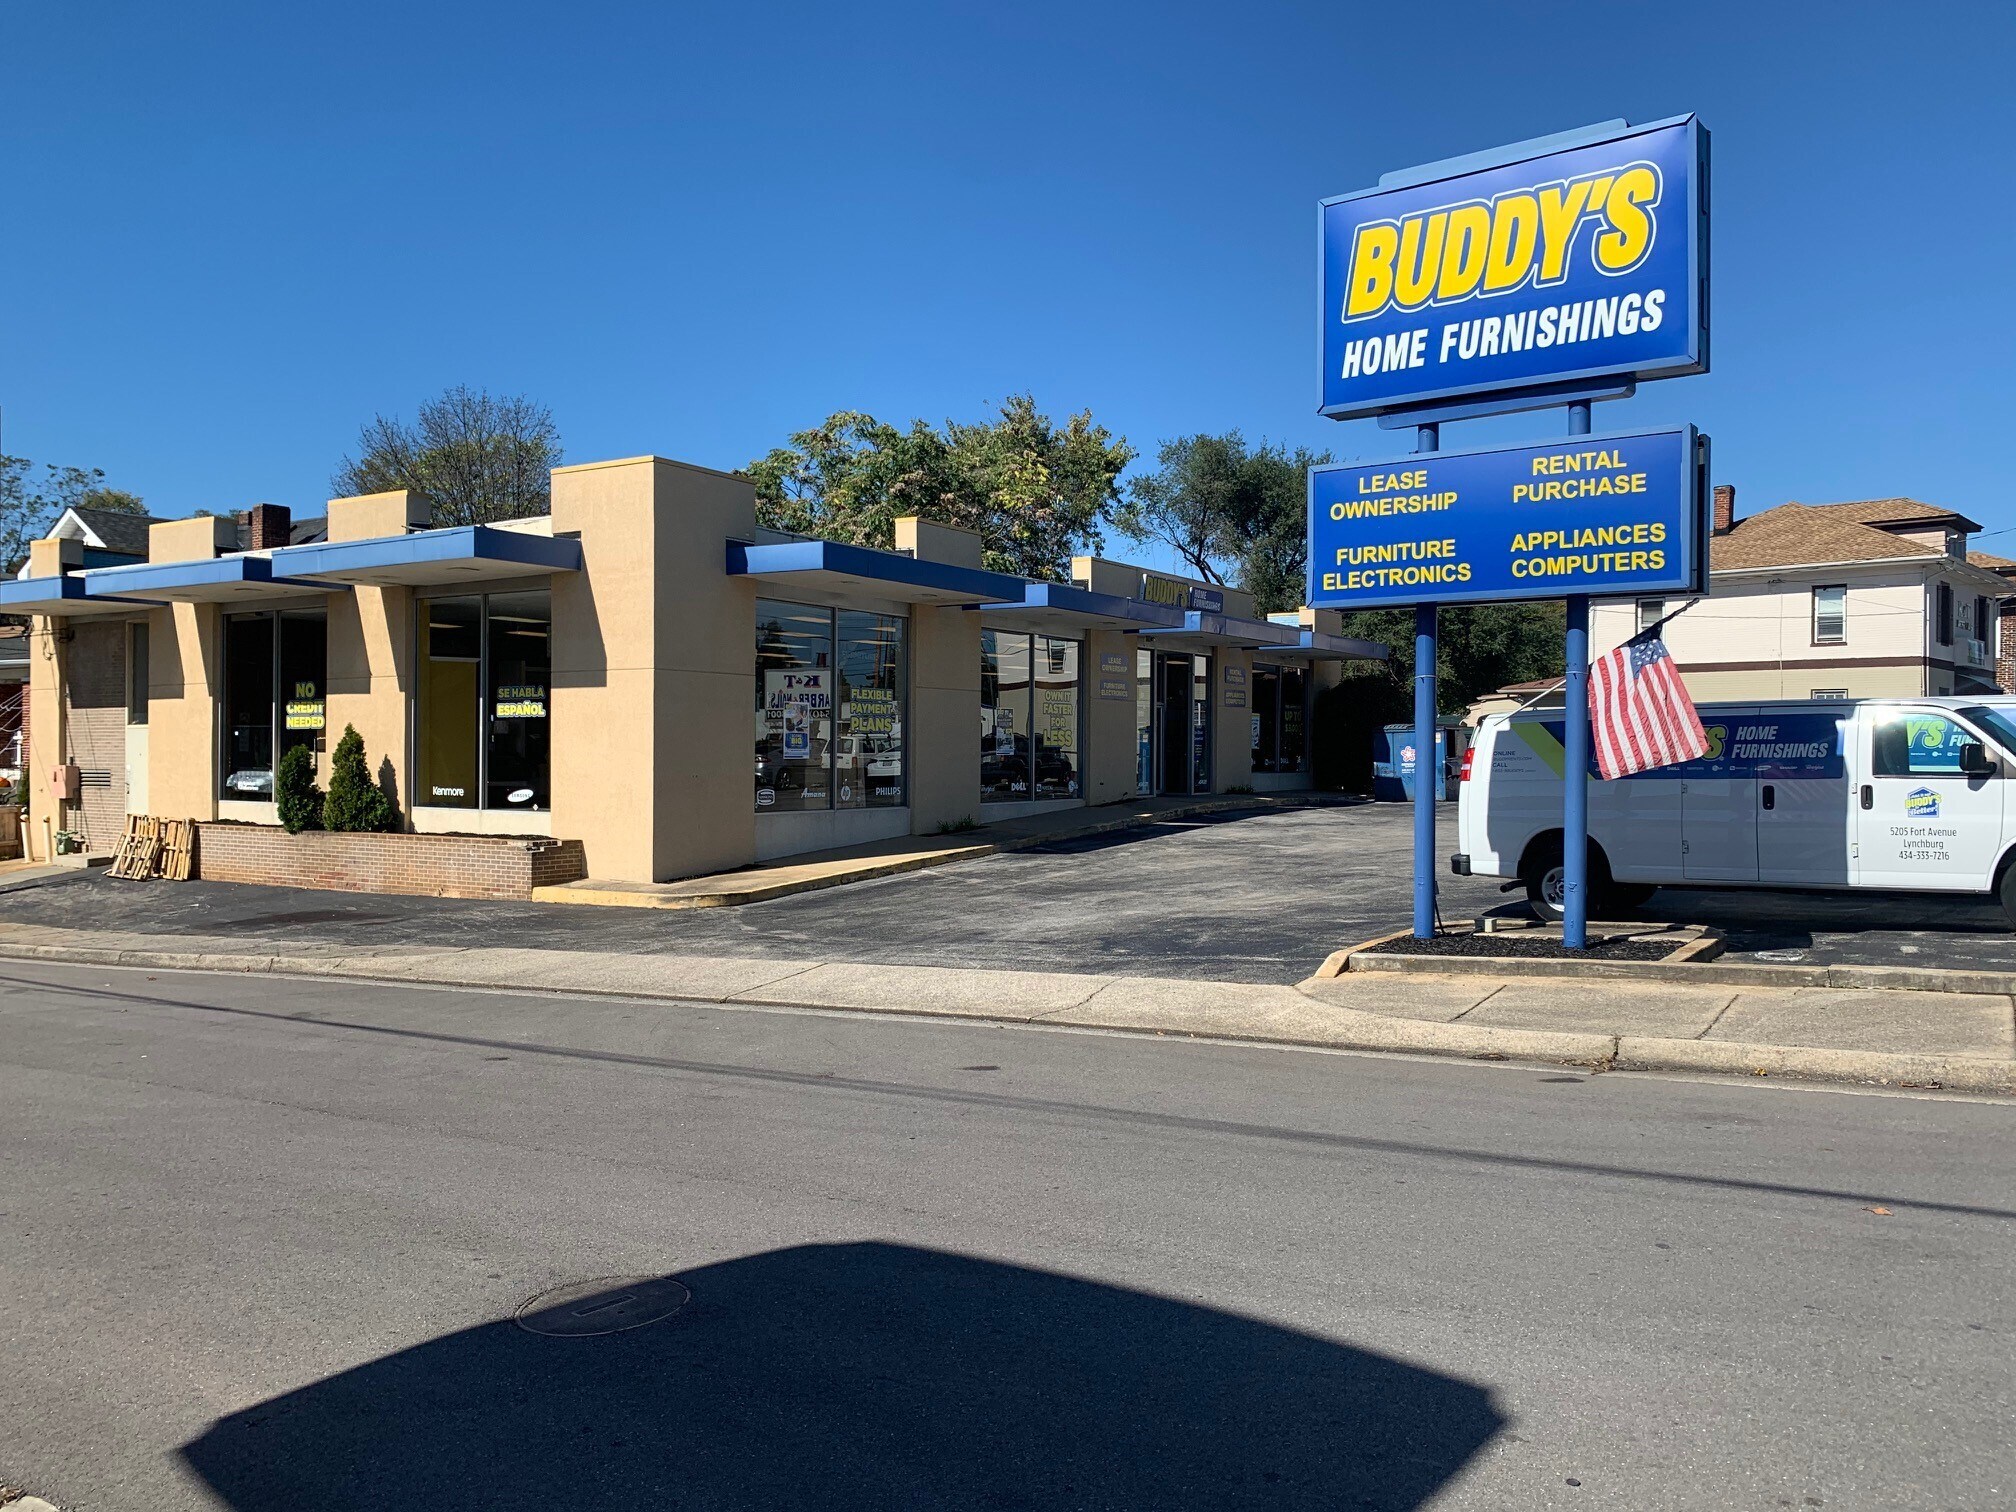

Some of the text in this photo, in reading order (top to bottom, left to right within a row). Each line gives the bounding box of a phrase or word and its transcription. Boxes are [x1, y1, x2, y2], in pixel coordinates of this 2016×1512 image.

[1345, 164, 1660, 320] BUDDY'S
[1341, 290, 1666, 379] HOME FURNISHINGS
[1532, 449, 1628, 476] RENTAL
[1359, 470, 1429, 495] LEASE
[1513, 473, 1647, 503] PURCHASE
[1330, 492, 1458, 521] OWNERSHIP
[1510, 523, 1666, 553] APPLIANCES
[1336, 539, 1456, 566] FURNITURE
[1511, 550, 1666, 579] COMPUTERS
[1323, 563, 1472, 591] ELECTRONICS
[1146, 576, 1189, 608] BUDDY'S
[295, 682, 315, 698] NO
[498, 686, 545, 698] SE HABLA
[851, 688, 893, 701] FLEXIBLE
[1045, 690, 1071, 702] OWN IT
[287, 701, 324, 714] CREDIT
[497, 700, 546, 716] ESPAÑOL
[851, 702, 892, 714] PAYMENT
[1043, 703, 1073, 715] FASTER
[287, 715, 324, 729] NEEDED
[851, 716, 893, 732] PLANS
[1050, 717, 1066, 727] FOR
[1043, 729, 1073, 747] LESS
[1736, 726, 1779, 741] HOME
[1731, 742, 1829, 759] FURNISHINGS
[432, 786, 465, 796] Kenmore
[801, 787, 826, 799] Amana
[875, 786, 901, 796] PHILIPS
[1905, 793, 1942, 809] BUDDY'S
[1890, 826, 1957, 837] 5205 Fort Avenue
[1903, 839, 1944, 850] Lynchburg
[1899, 851, 1950, 860] 434-333-7216
